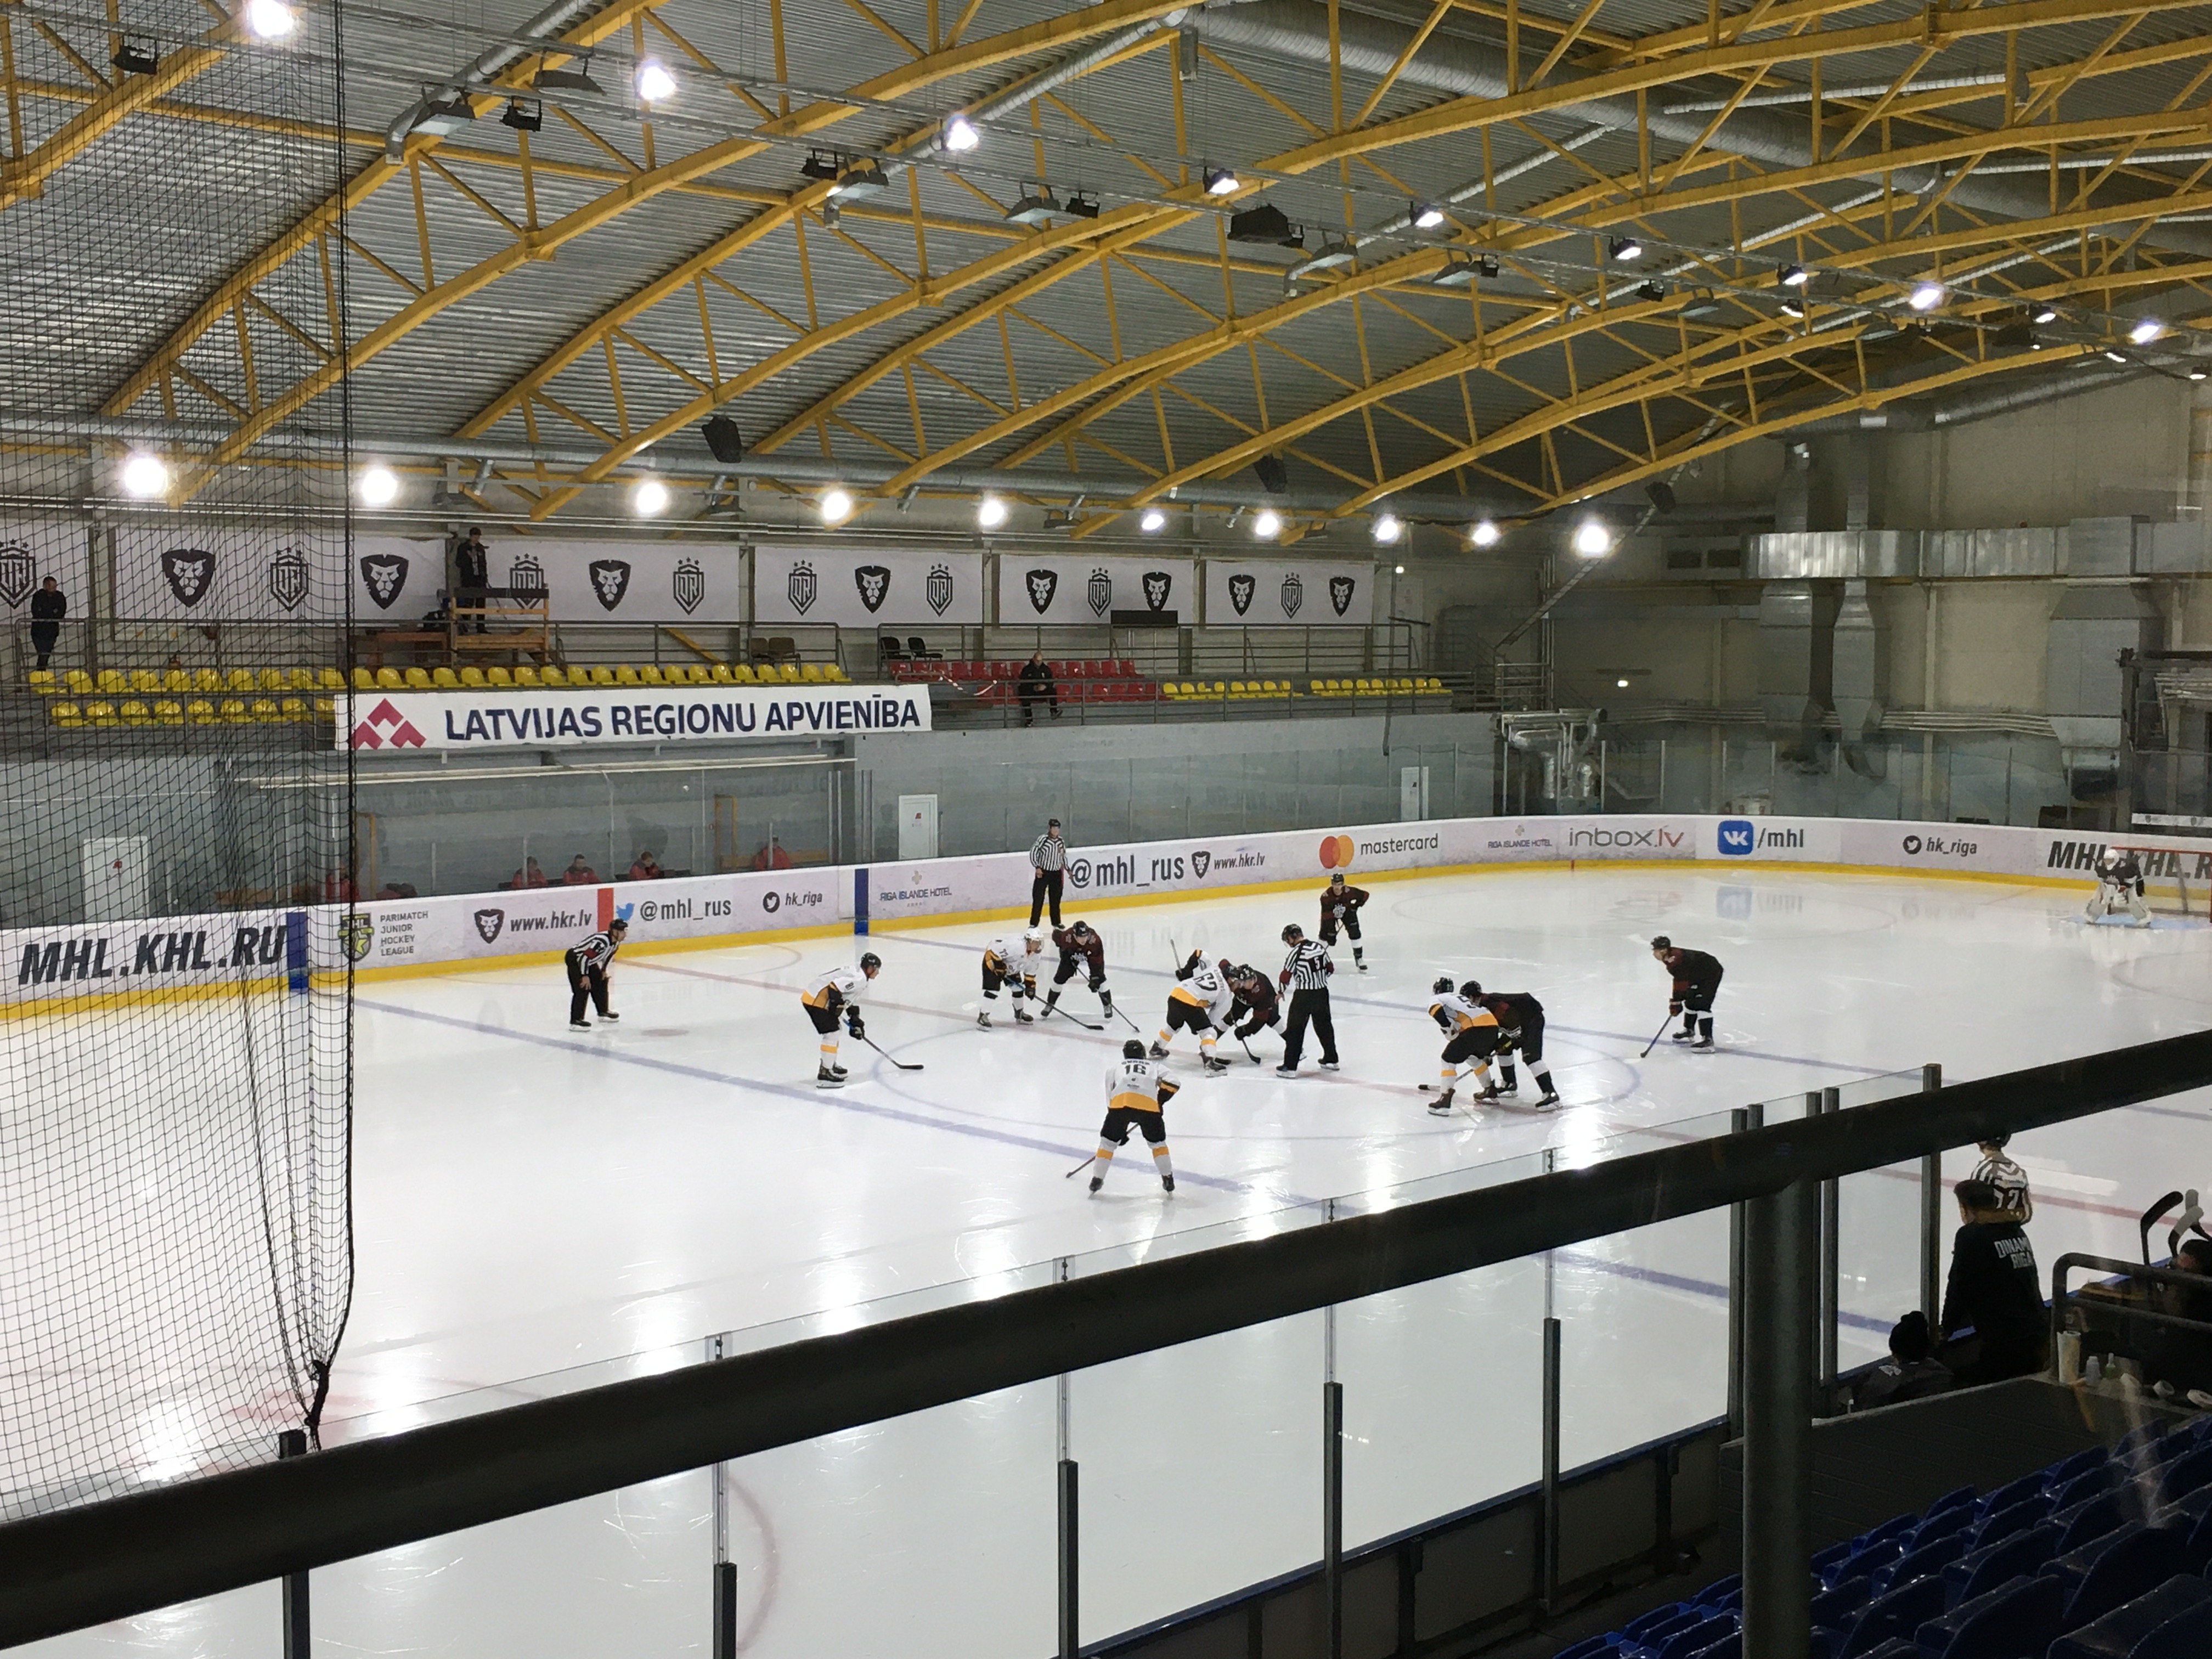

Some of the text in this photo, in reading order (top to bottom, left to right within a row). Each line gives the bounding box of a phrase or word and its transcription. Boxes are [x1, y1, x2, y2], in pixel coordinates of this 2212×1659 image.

[445, 706, 603, 741] LATVIJAS
[765, 694, 921, 731] APVIENĪBA
[1361, 833, 1438, 855] mastercard
[1569, 827, 1684, 848] inbox.lv
[1723, 831, 1748, 846] VK
[1926, 837, 1977, 857] hk_riga
[1214, 853, 1265, 870] www.hkr.lv
[1071, 854, 1184, 888] @mhl_rus
[785, 891, 822, 907] hk_riga
[879, 892, 897, 901] RIGA
[930, 887, 952, 896] HOTEL
[380, 911, 428, 922] PARIMATCH
[640, 898, 731, 921] @mhl_rus
[380, 924, 413, 934] JUNIOR
[510, 909, 592, 932] www.hkr.lv
[381, 934, 415, 945] HOCKEY
[18, 925, 288, 985] MHL.KHL.RU
[381, 946, 414, 956] LEAGUE
[1125, 1064, 1146, 1075] 16
